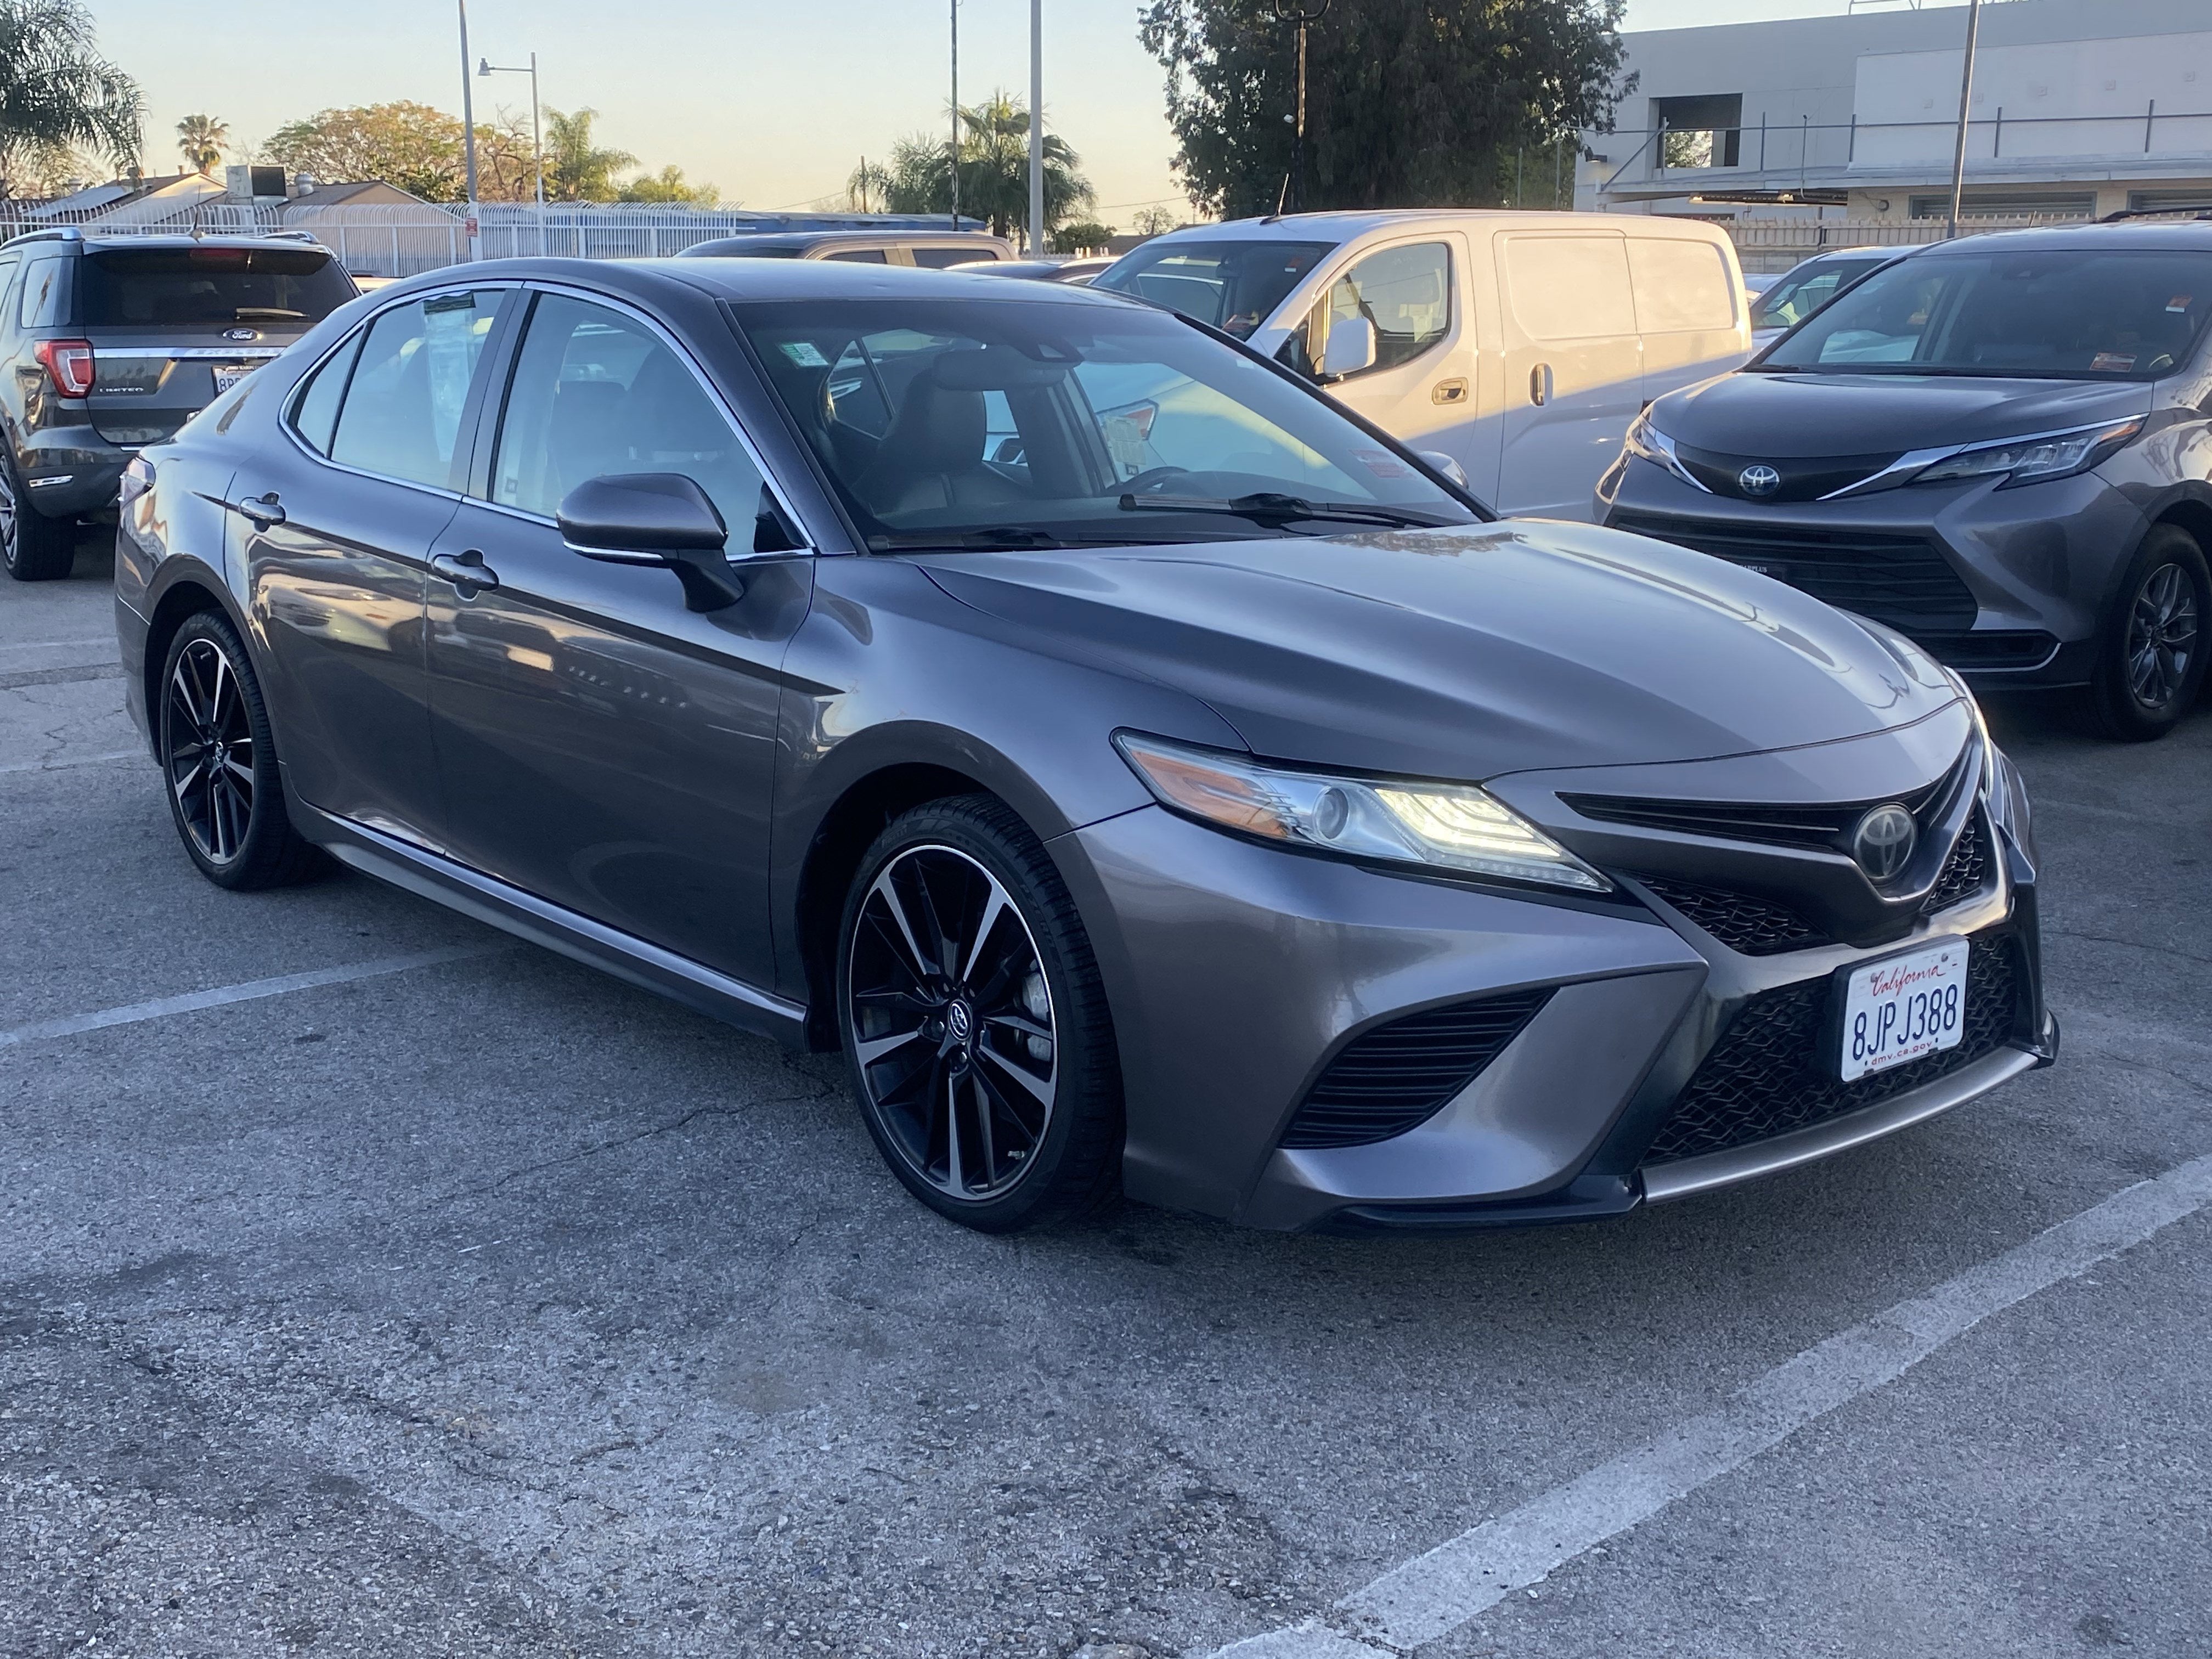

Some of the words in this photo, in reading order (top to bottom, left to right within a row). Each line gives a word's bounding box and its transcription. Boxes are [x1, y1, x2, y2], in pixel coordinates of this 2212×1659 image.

[232, 330, 253, 339] Ford
[1871, 964, 1946, 997] California
[1852, 984, 1958, 1060] 8JPJ388
[1871, 1041, 1932, 1065] dmv.ca.gov
